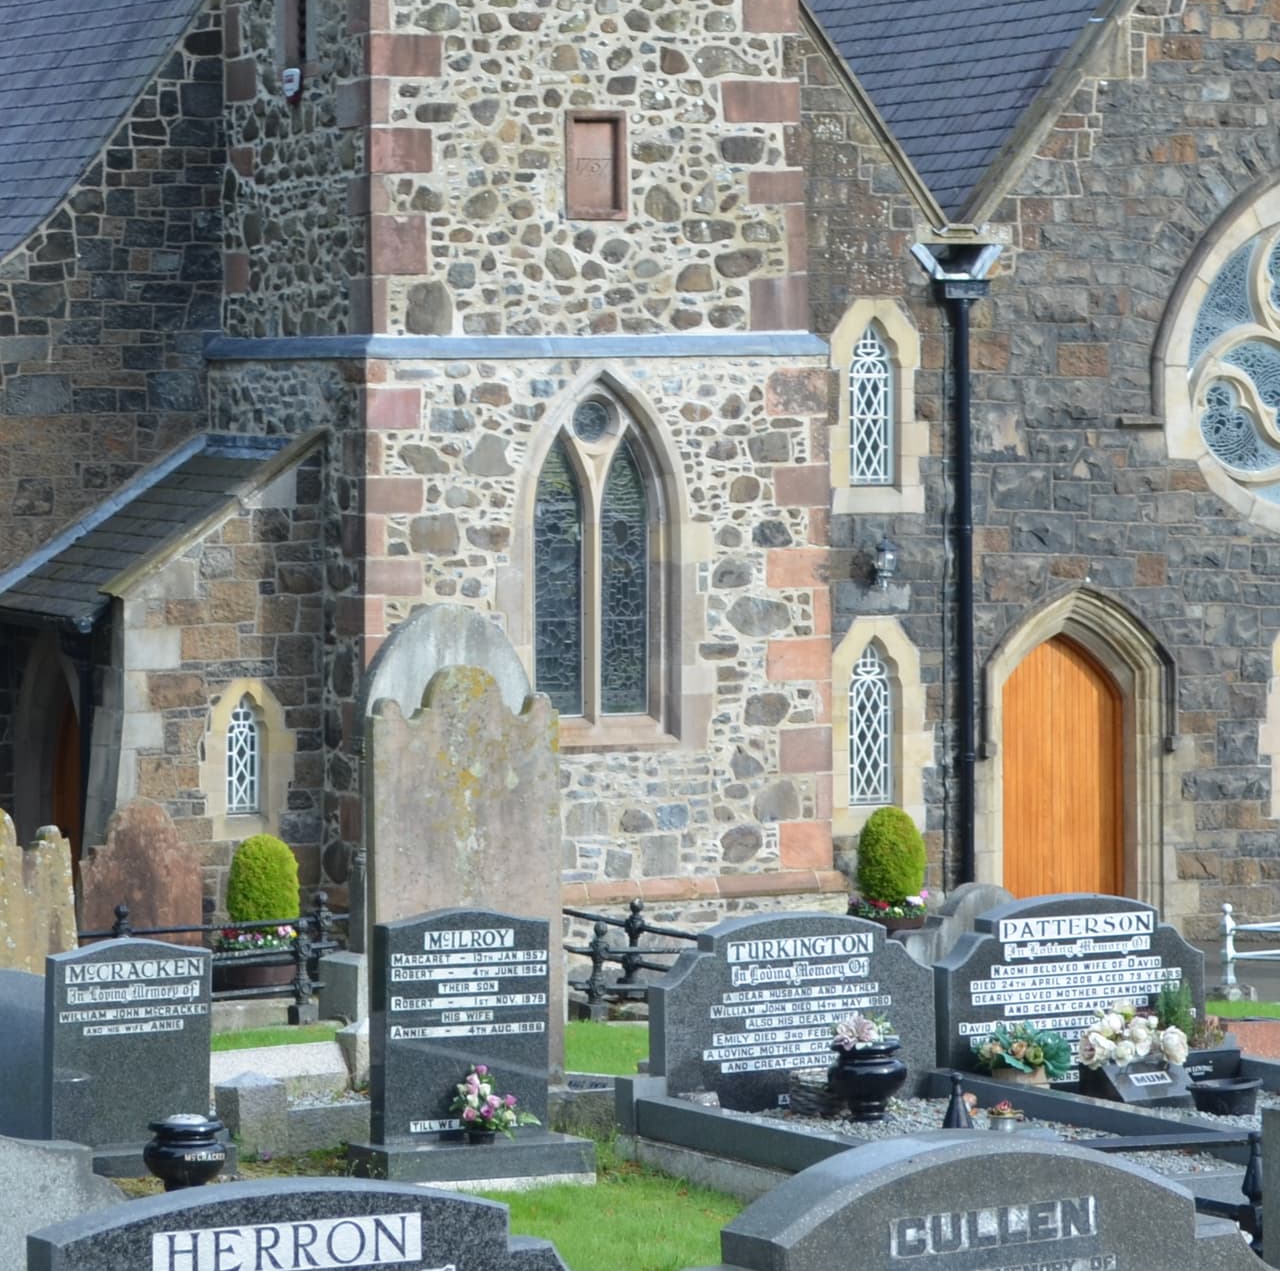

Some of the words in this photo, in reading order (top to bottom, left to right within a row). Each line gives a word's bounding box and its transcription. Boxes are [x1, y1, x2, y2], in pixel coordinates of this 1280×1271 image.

[1004, 914, 1151, 939] PATTERSON
[731, 935, 869, 961] TURKINGTON
[394, 954, 451, 965] MARGARET
[523, 951, 545, 959] 1957
[394, 969, 434, 979] ROBERT
[495, 967, 518, 975] JUNE
[750, 965, 791, 984] Loving
[794, 962, 845, 984] Memory
[993, 965, 1028, 976] NAOMI
[1033, 964, 1078, 974] BELOVED
[1084, 962, 1107, 970] WIFE
[1128, 958, 1160, 967] DAVID
[972, 981, 996, 990] DIED
[1031, 977, 1060, 986] APRIL
[1098, 973, 1124, 982] AGED
[1147, 968, 1181, 978] YEARS
[70, 989, 84, 1003] In
[90, 988, 128, 1002] Loving
[131, 984, 177, 998] Memory
[442, 984, 469, 992] THEIR
[477, 982, 495, 990] SON
[739, 992, 764, 1000] DEAR
[770, 988, 812, 998] HUSBAND
[818, 987, 836, 995] AND
[842, 984, 876, 992] FATHER
[974, 993, 1012, 1002] DEARLY
[1019, 991, 1052, 1000] LOVED
[1056, 987, 1097, 997] MOTHER
[394, 998, 434, 1008] ROBERT
[496, 996, 518, 1004] NOV.
[712, 1006, 755, 1017] WILLIAM
[762, 1004, 786, 1013] JOHN
[792, 1002, 811, 1011] DIED
[842, 998, 862, 1006] MAY
[1008, 1005, 1029, 1013] AND
[1034, 1002, 1066, 1011] GREAT
[61, 1012, 106, 1022] WILLIAM
[113, 1009, 139, 1018] JOHN
[444, 1013, 460, 1021] HIS
[466, 1012, 491, 1020] WIFE
[748, 1019, 774, 1027] ALSO
[778, 1016, 793, 1024] HIS
[799, 1014, 826, 1023] DEAR
[151, 1021, 181, 1030] ANNIE
[393, 1028, 427, 1037] ANNIE
[468, 1026, 487, 1034] 4TH
[491, 1024, 515, 1032] AUG.
[961, 1024, 991, 1033] DAVID
[717, 1033, 749, 1045] EMILY
[754, 1033, 777, 1042] DIED
[718, 1047, 755, 1058] LOVING
[760, 1043, 800, 1054] MOTHER
[727, 1062, 747, 1070] AND
[1134, 1073, 1167, 1083] MUM
[413, 1122, 432, 1130] TILL
[896, 1196, 1092, 1257] CULLEN
[168, 1215, 407, 1271] HERRON
